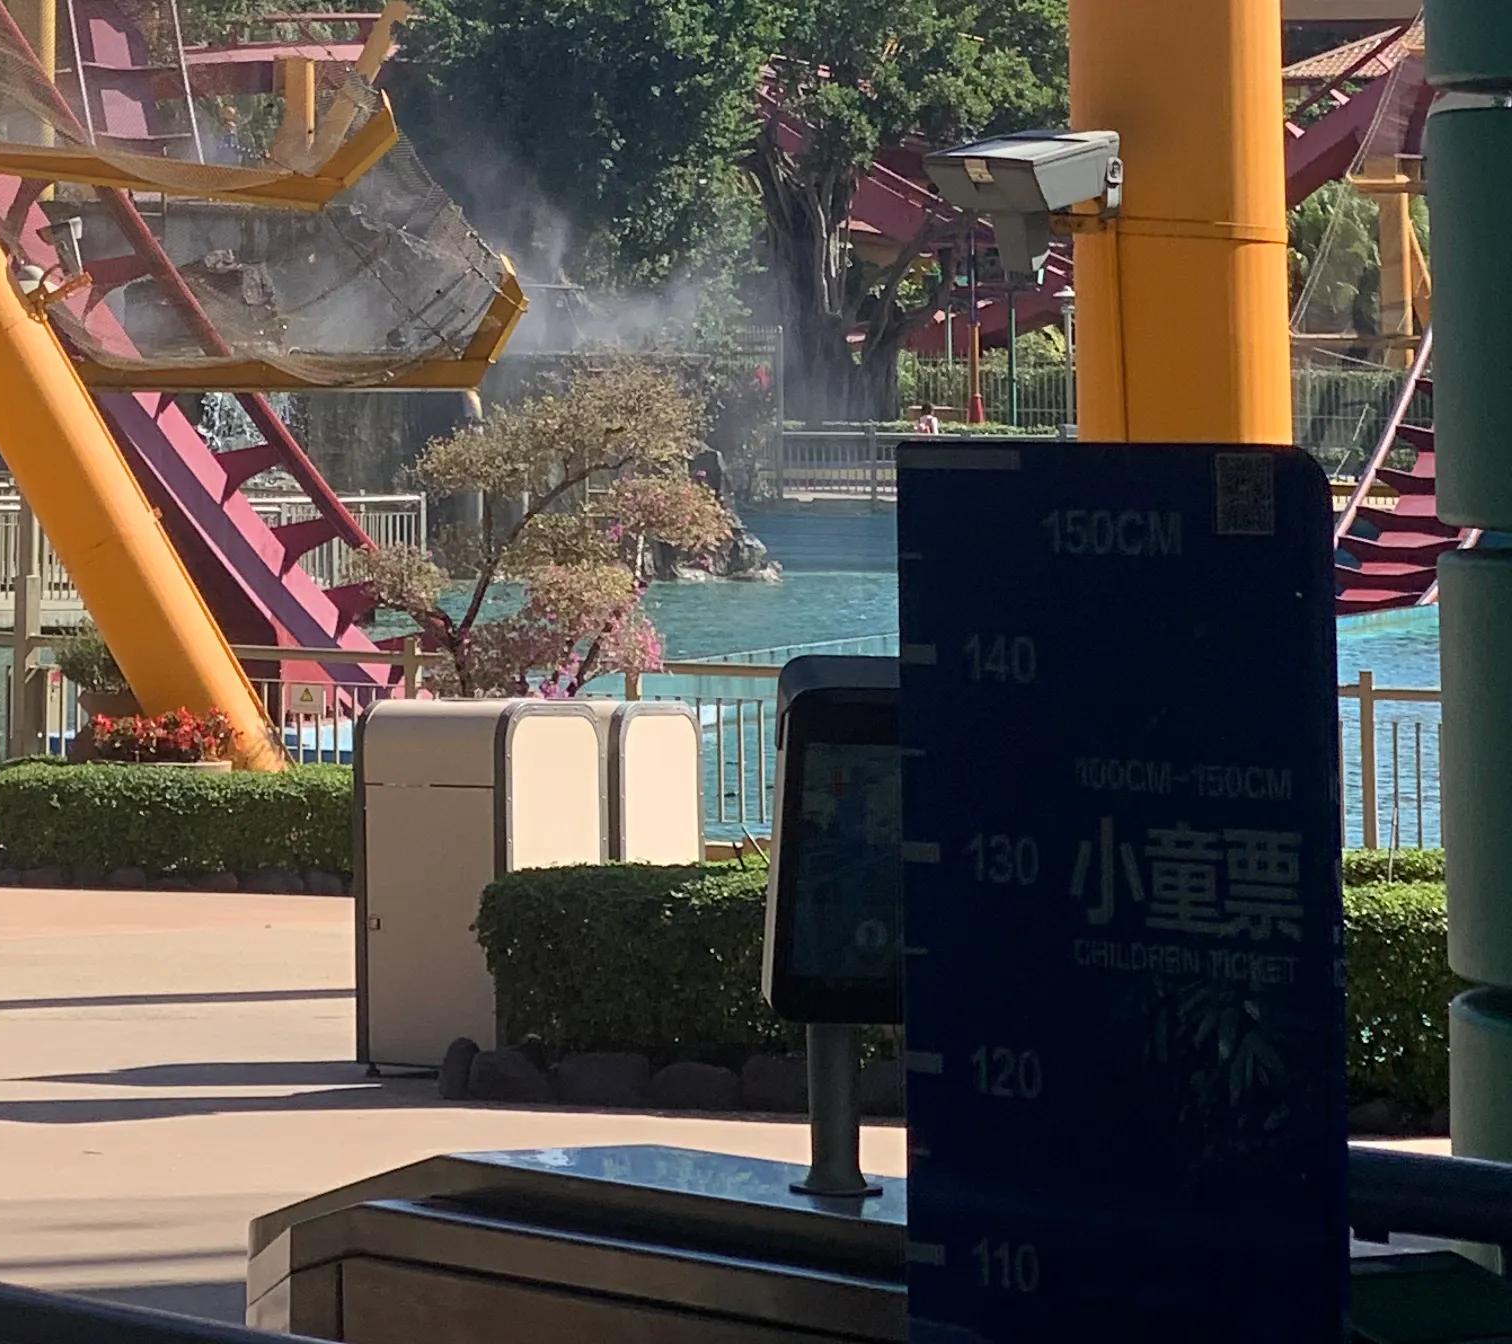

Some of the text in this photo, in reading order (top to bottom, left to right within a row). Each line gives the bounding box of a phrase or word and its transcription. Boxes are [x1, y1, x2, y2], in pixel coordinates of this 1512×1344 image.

[1041, 508, 1183, 557] 150CM
[965, 633, 1037, 685] 140
[966, 833, 1039, 885] 130
[1069, 816, 1304, 943] 小童票
[970, 1044, 1042, 1099] 120
[972, 1237, 1040, 1293] 110
